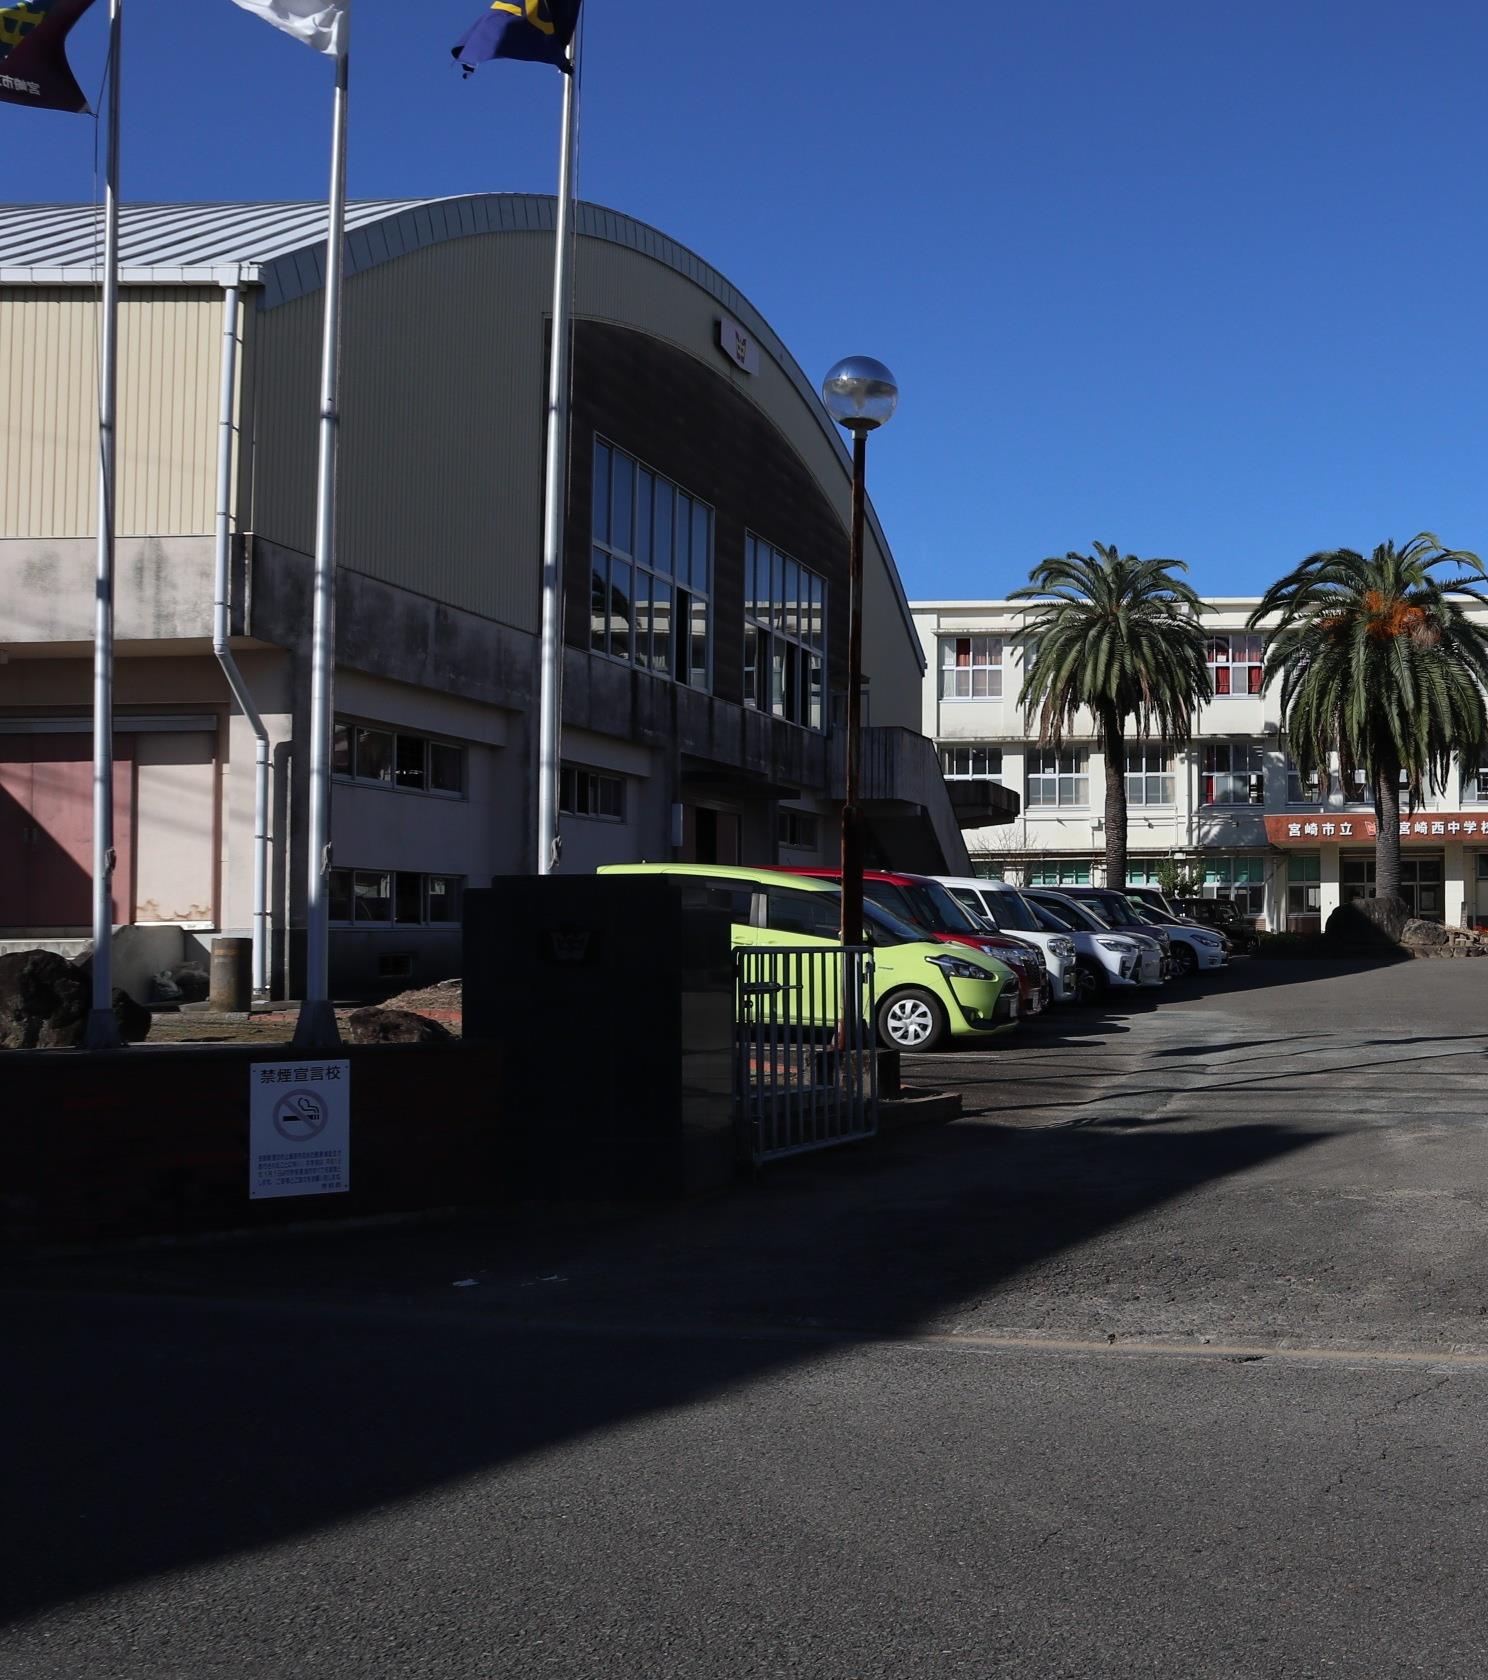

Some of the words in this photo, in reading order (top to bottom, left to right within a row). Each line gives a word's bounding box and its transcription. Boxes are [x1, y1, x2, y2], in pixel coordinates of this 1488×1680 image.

[1288, 823, 1353, 837] 宮崎市立
[261, 1066, 341, 1084] 禁煙宣言校
